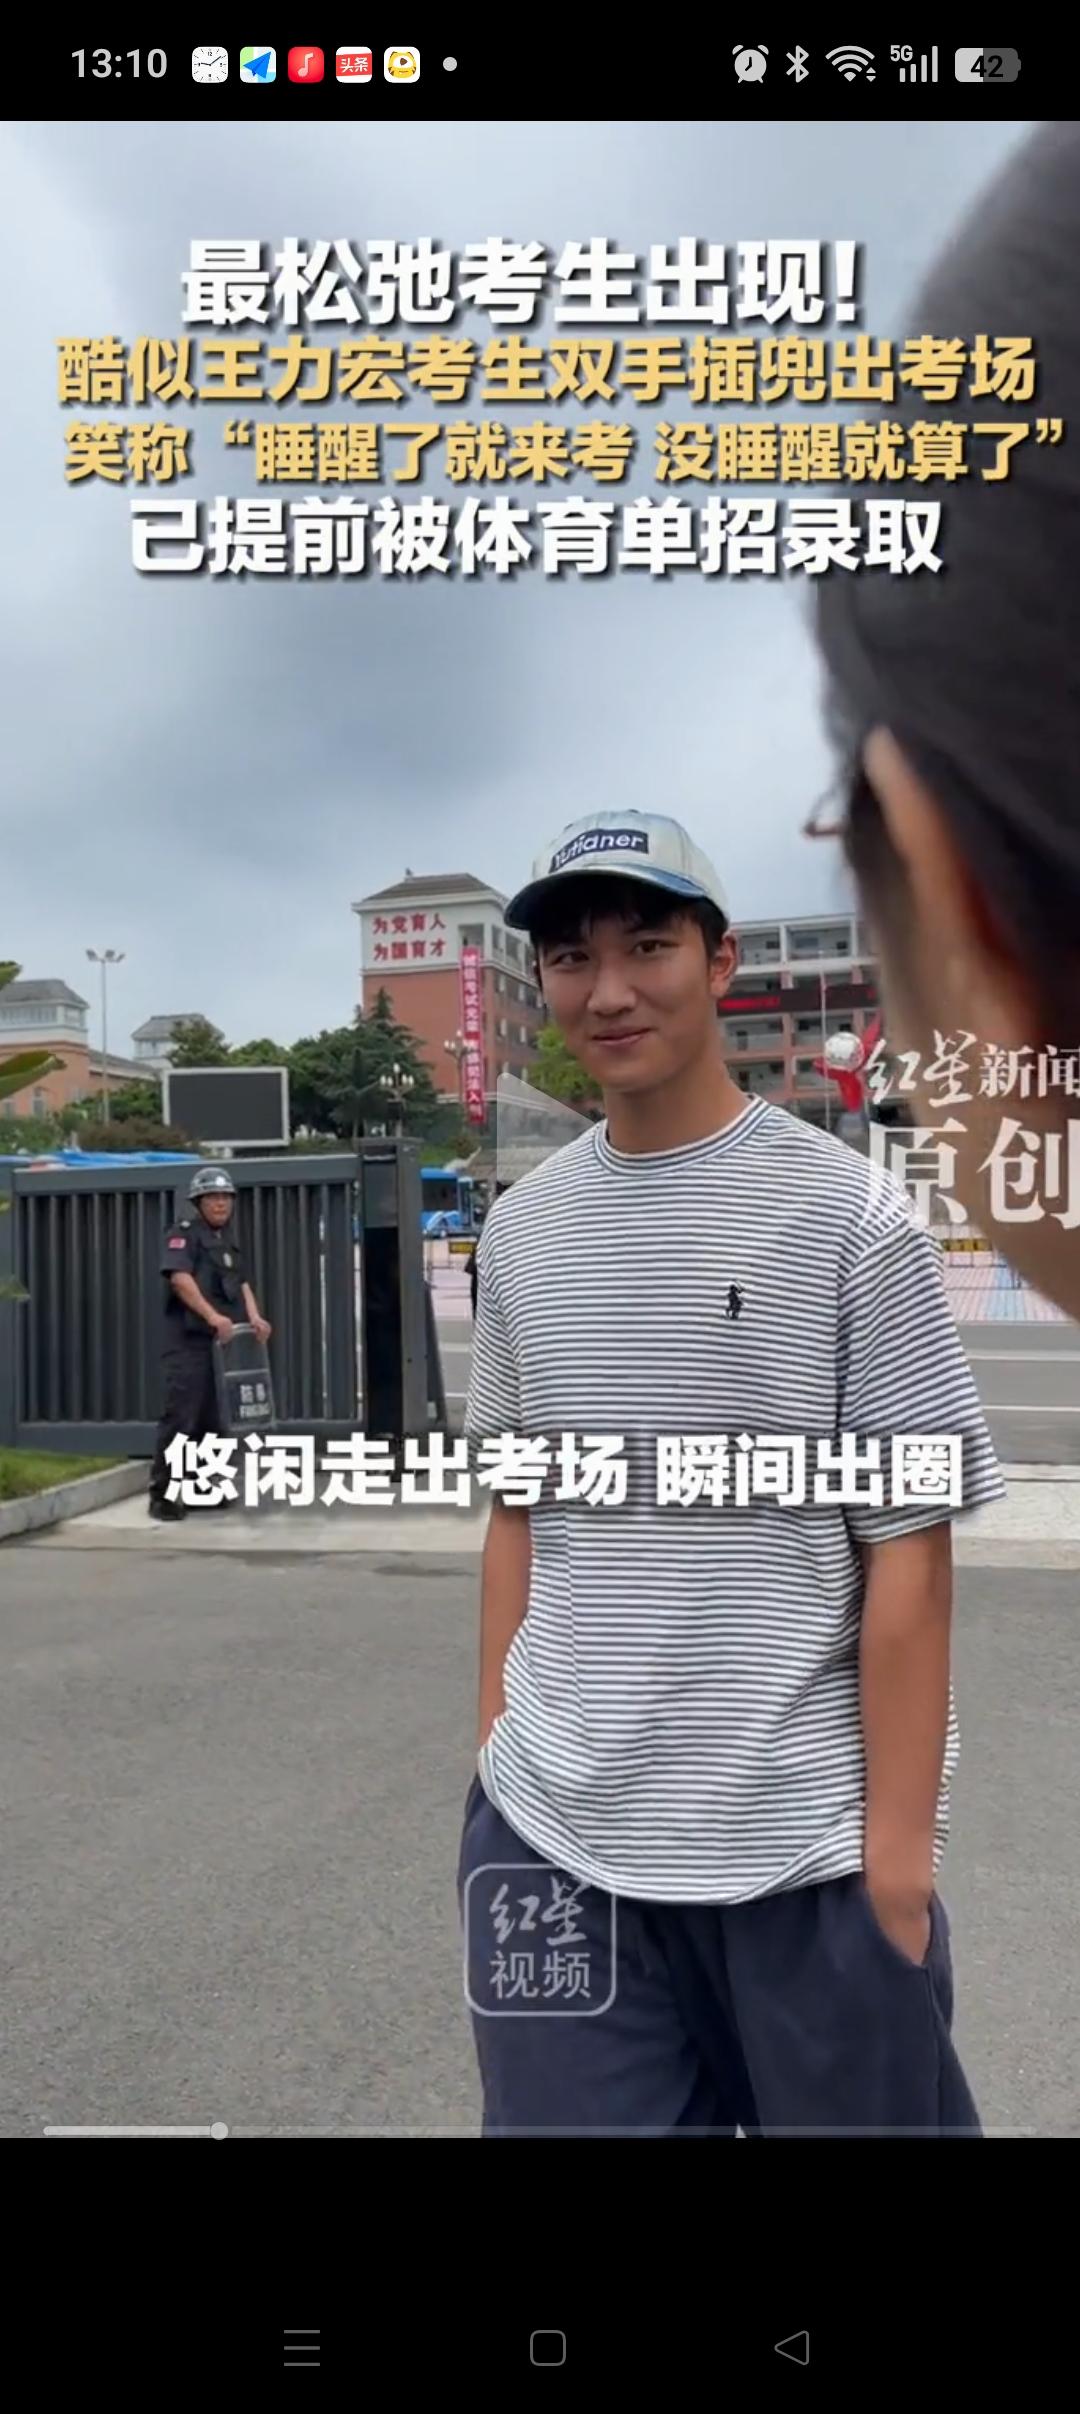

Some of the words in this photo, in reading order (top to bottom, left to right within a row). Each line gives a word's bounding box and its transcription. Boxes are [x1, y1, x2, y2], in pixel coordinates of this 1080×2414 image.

[372, 913, 447, 935] 为党育人
[374, 938, 446, 961] 为国育才
